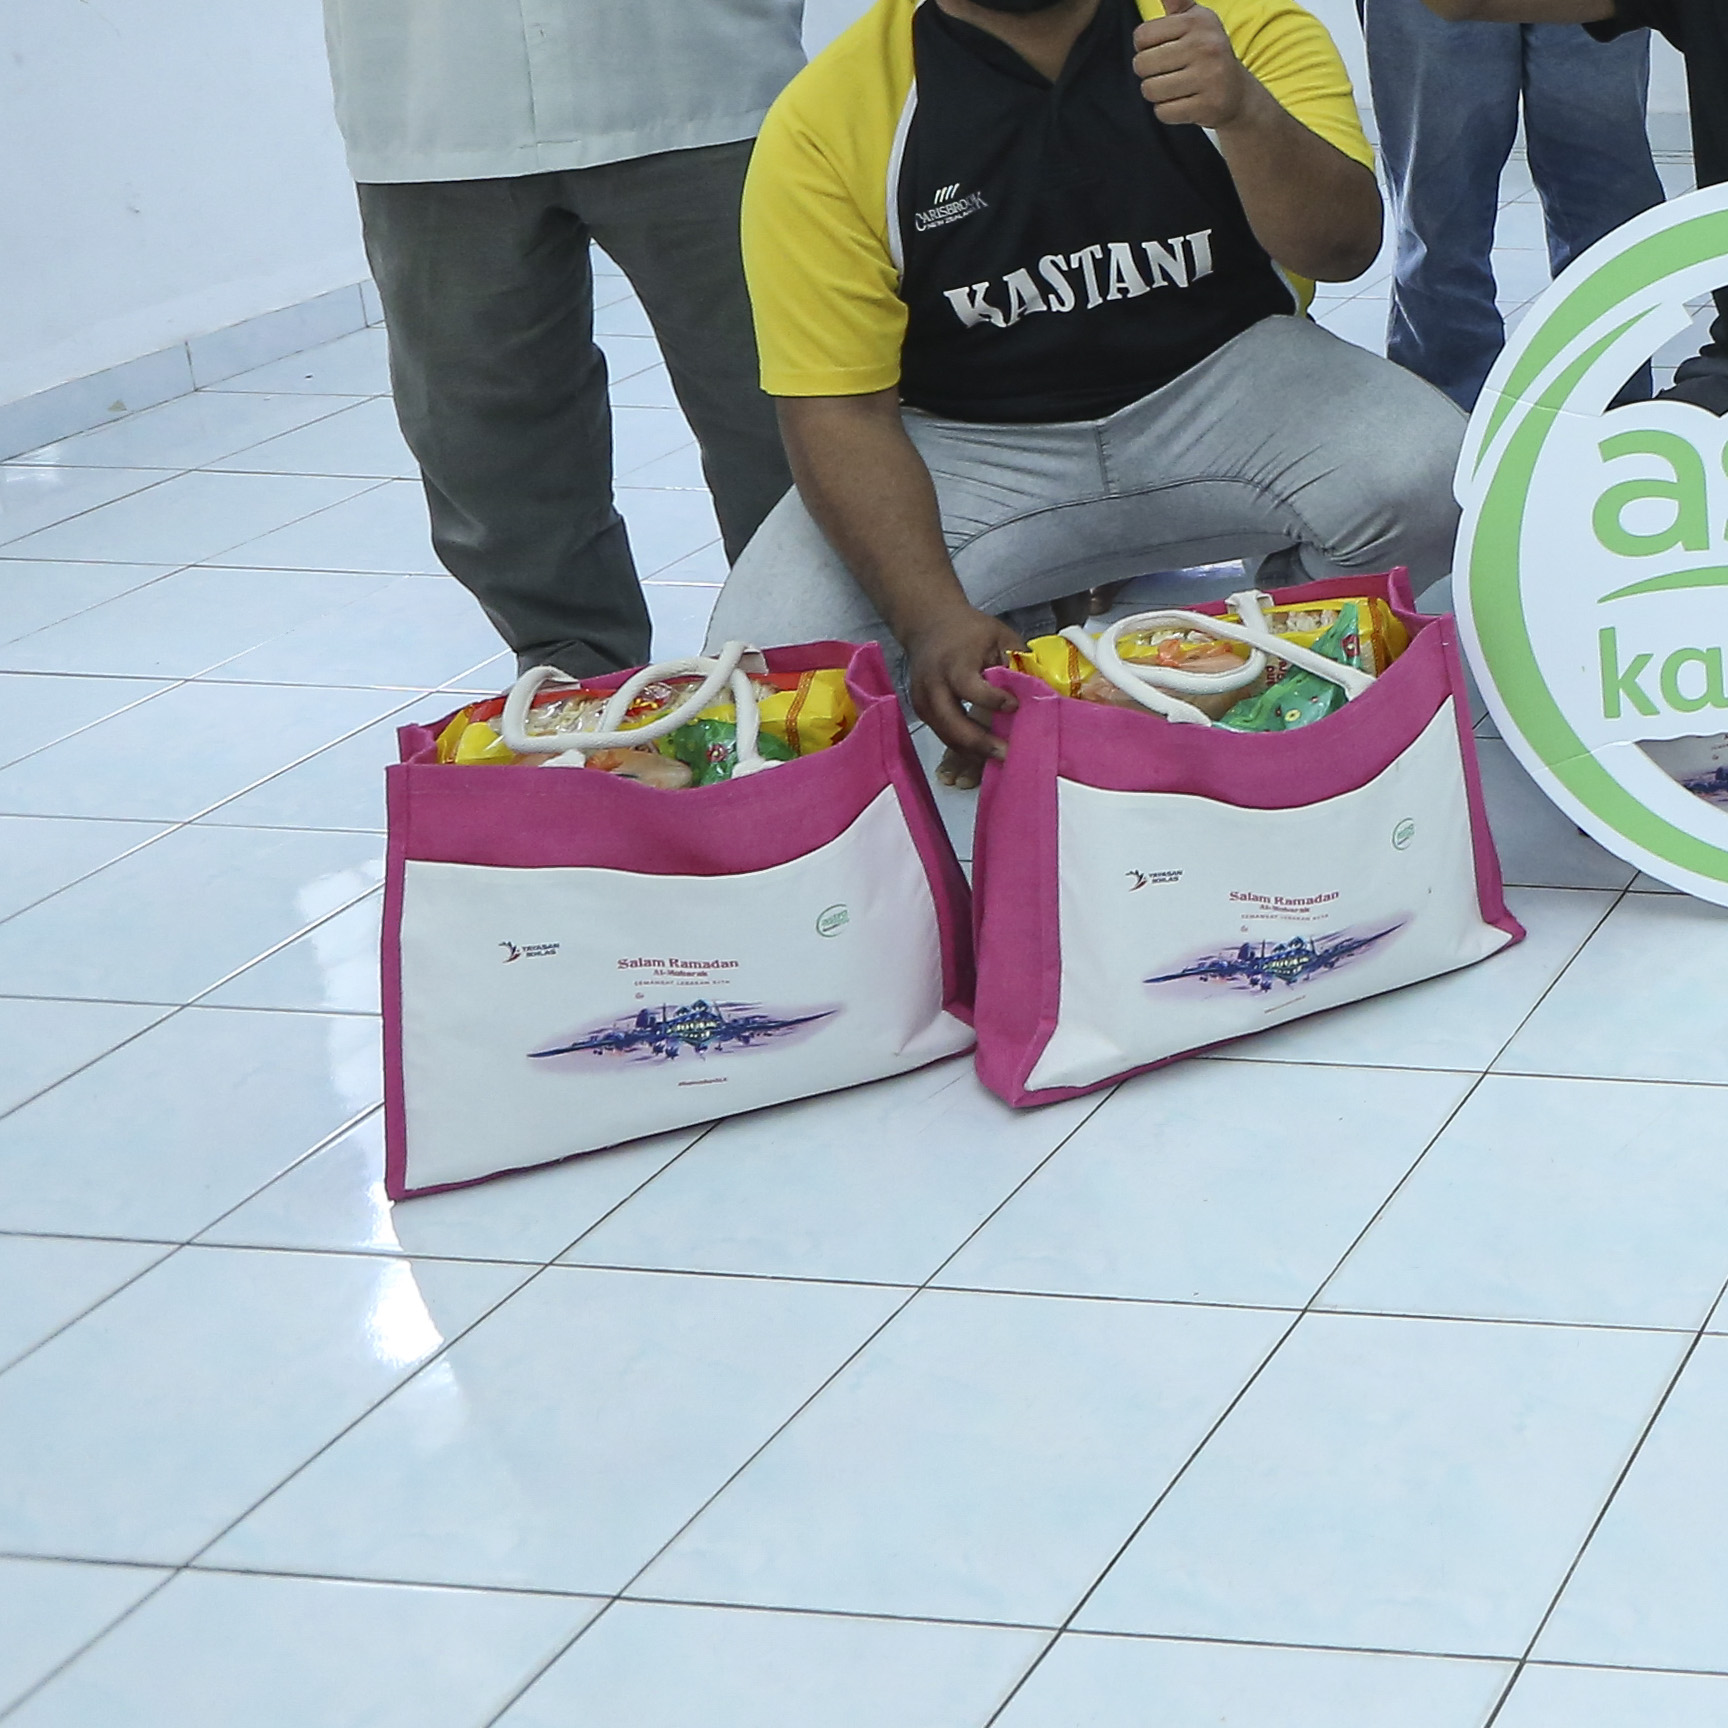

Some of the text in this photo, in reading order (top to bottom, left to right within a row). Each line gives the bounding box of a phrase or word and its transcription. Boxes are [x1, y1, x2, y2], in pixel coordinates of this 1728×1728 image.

[943, 229, 1213, 328] KASTANI
[1229, 890, 1340, 906] Salam Ramadan
[617, 957, 739, 970] Salam Ramadan
